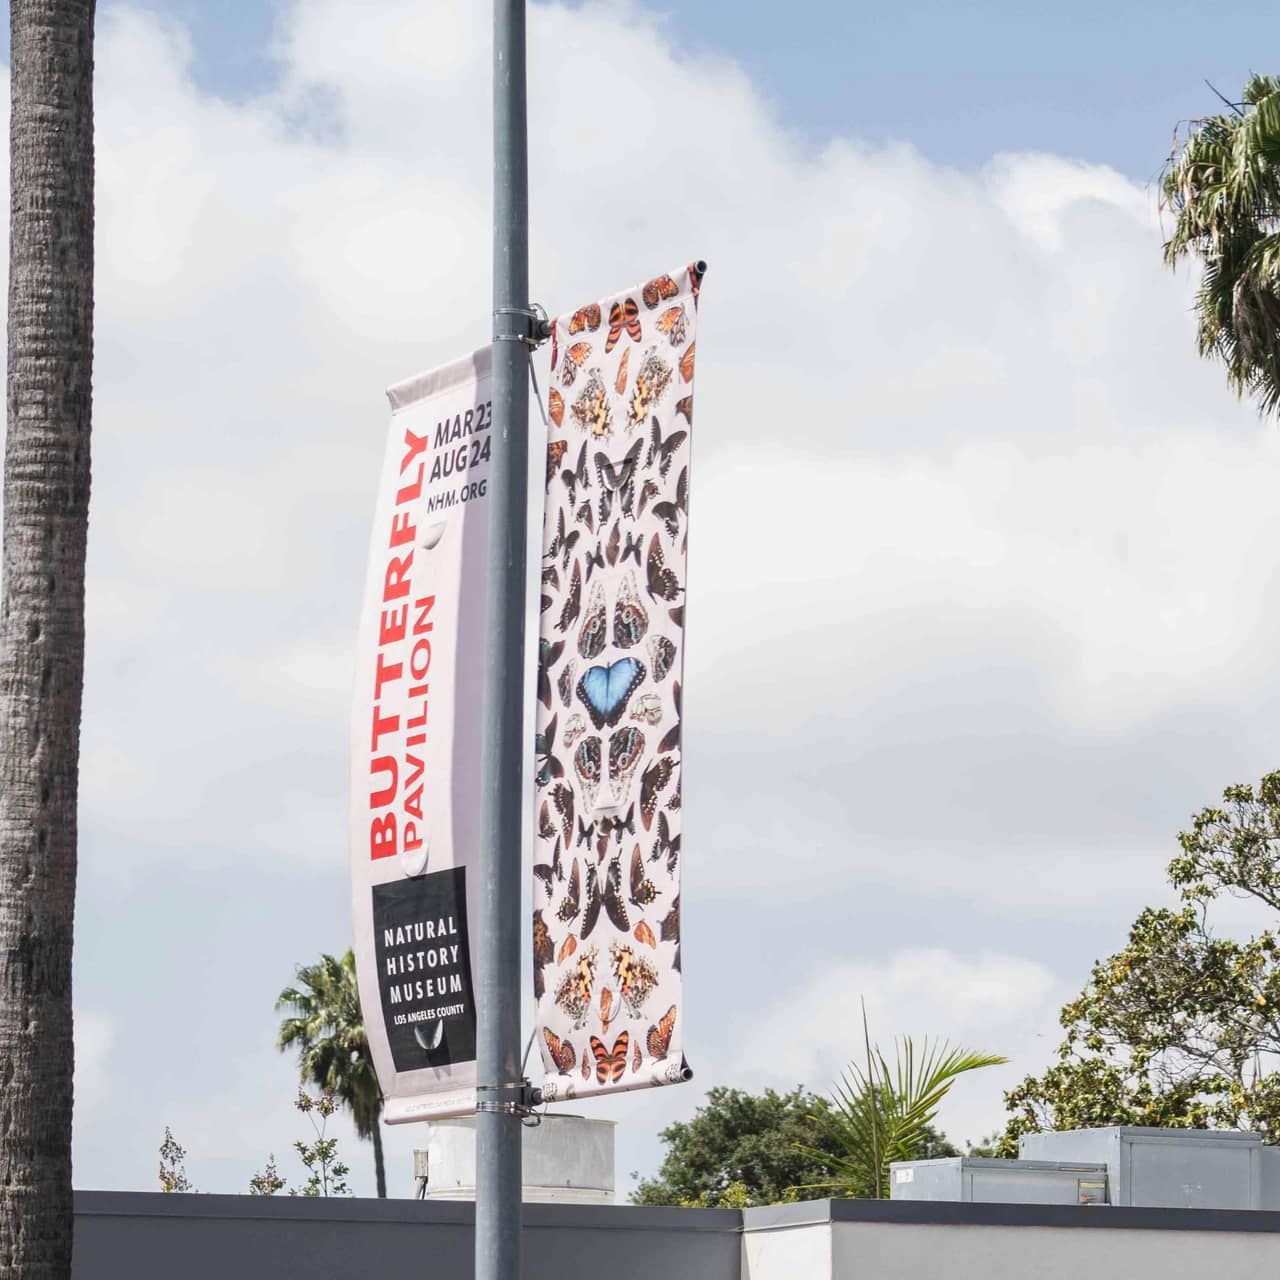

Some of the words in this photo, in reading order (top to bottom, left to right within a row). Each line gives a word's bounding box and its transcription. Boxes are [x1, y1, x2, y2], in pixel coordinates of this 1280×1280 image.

[433, 408, 474, 449] MAR
[429, 445, 468, 483] AUG
[469, 435, 491, 468] 24
[427, 479, 487, 514] NHM.ORG
[370, 428, 428, 861] BUTTERFLY
[403, 595, 436, 853] PAVILION
[384, 916, 457, 947] NATURAL
[386, 945, 459, 976] HISTORY
[390, 974, 462, 1004] MUSEUM
[394, 1014, 407, 1025] LOS
[407, 1009, 436, 1022] ANGELES
[436, 1004, 464, 1017] COUNTY
